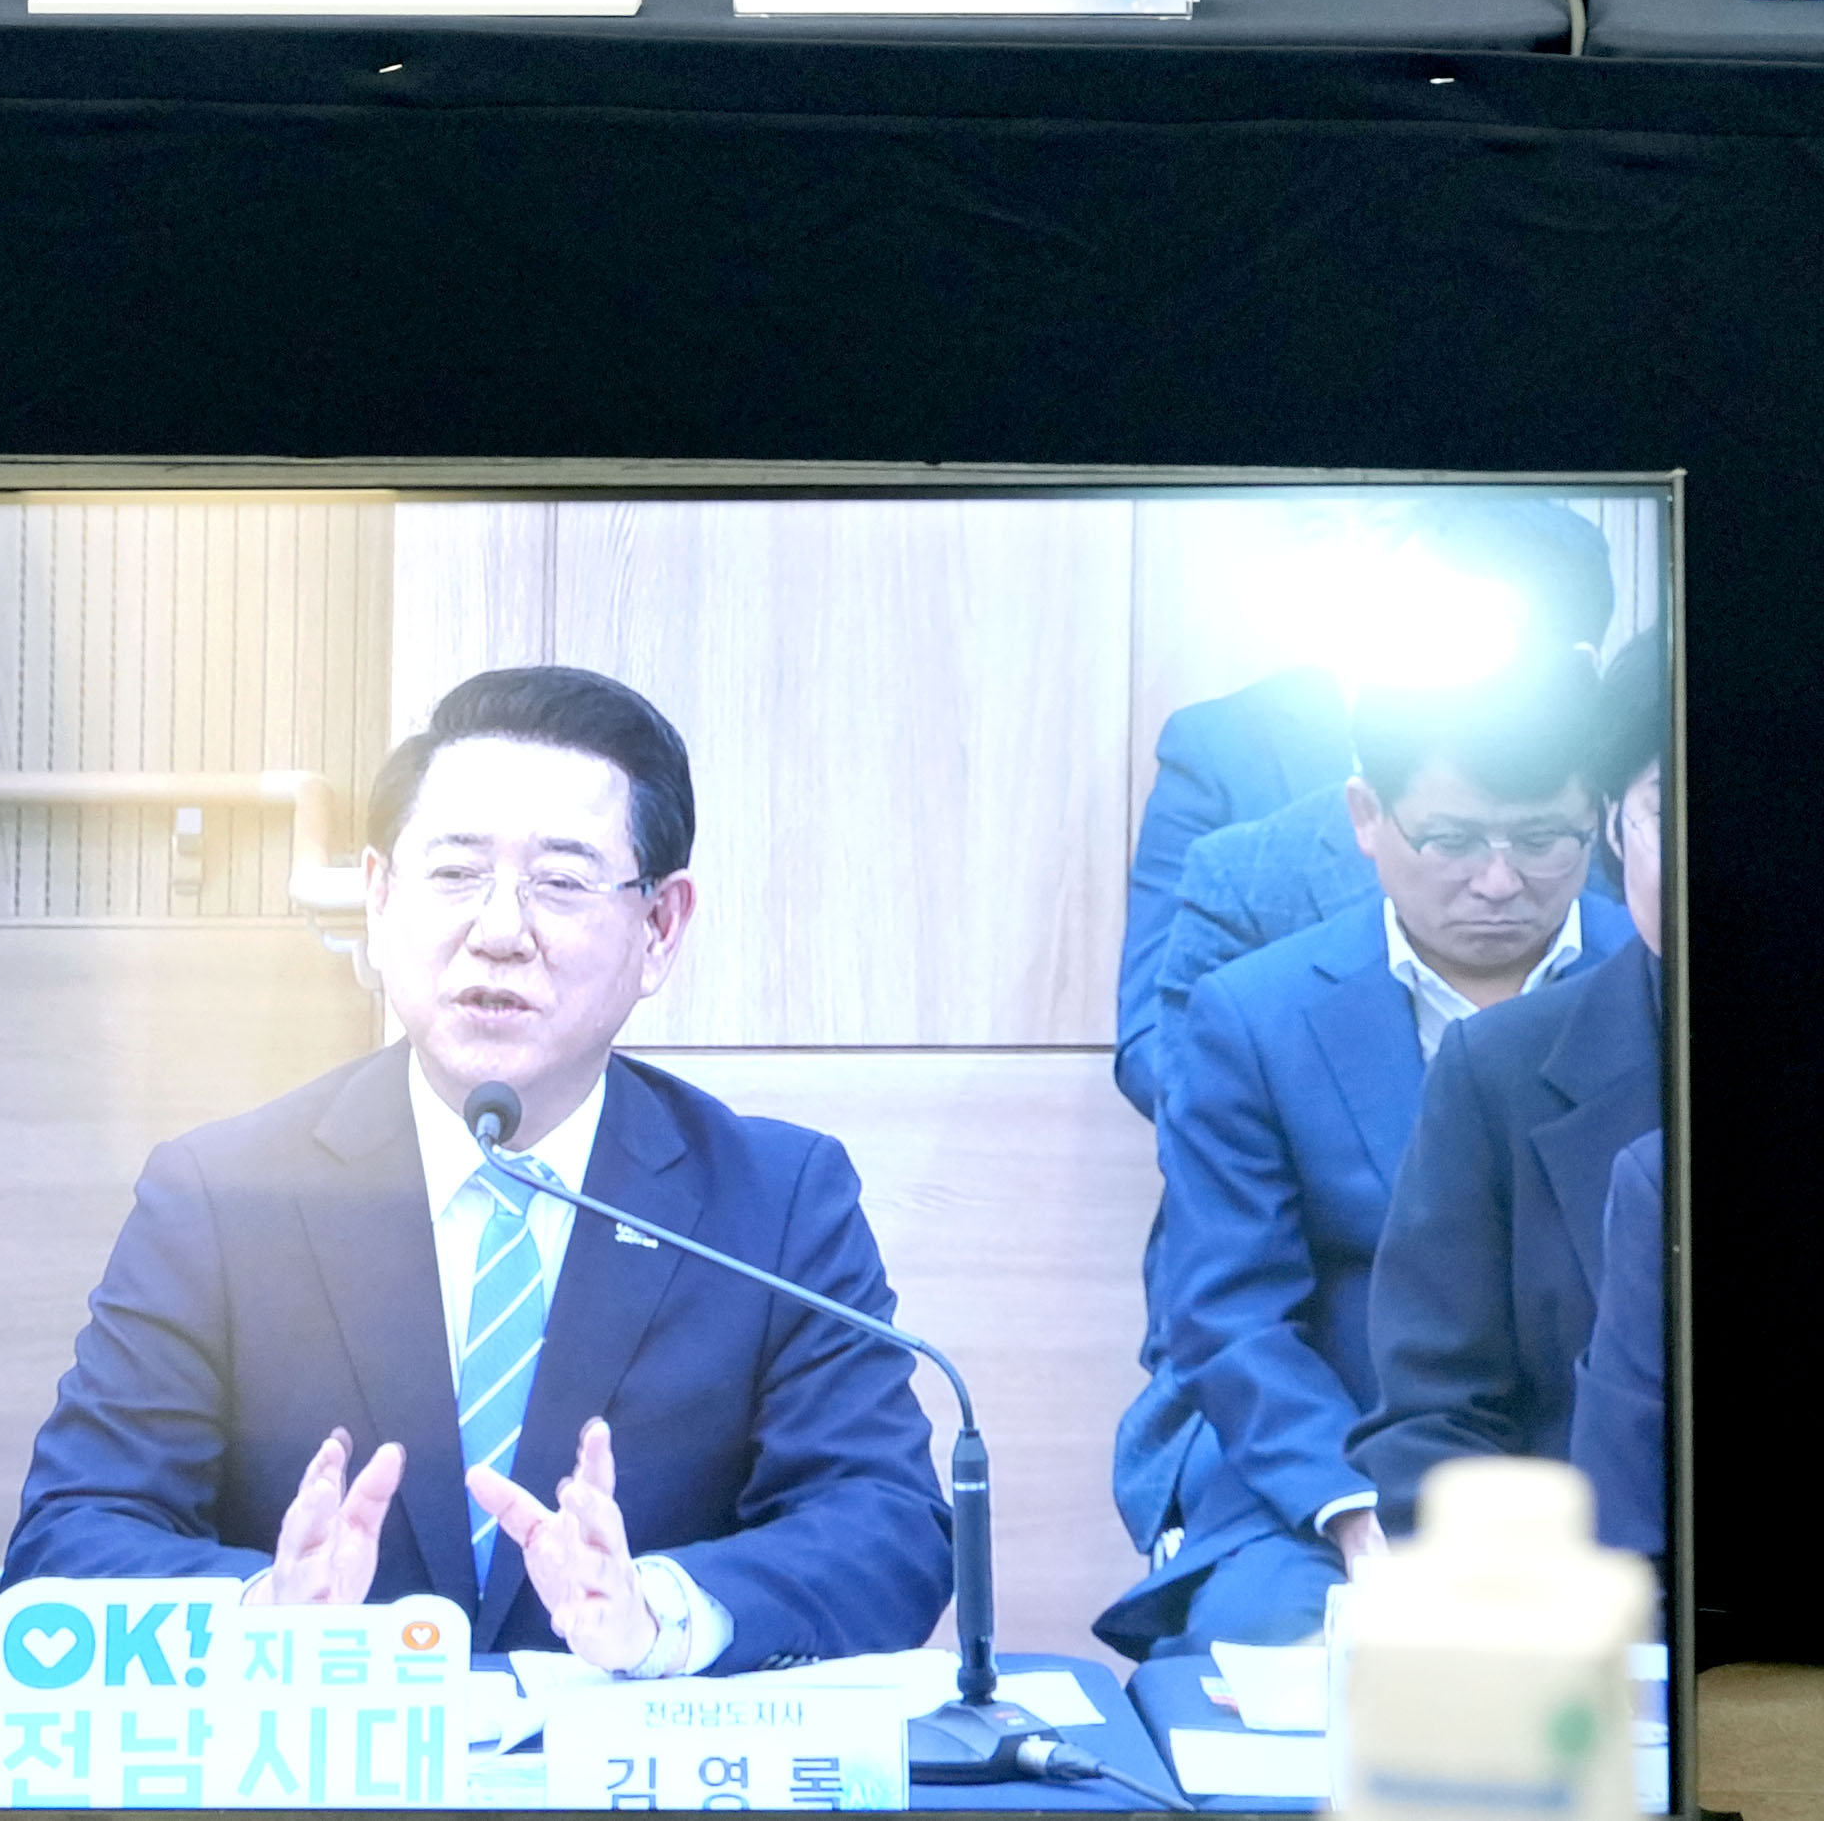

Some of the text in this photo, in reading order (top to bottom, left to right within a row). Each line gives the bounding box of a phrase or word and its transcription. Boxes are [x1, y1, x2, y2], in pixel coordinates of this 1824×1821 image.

[3, 1602, 448, 1689] OK! 지금은
[644, 1700, 805, 1730] 전라남도지사
